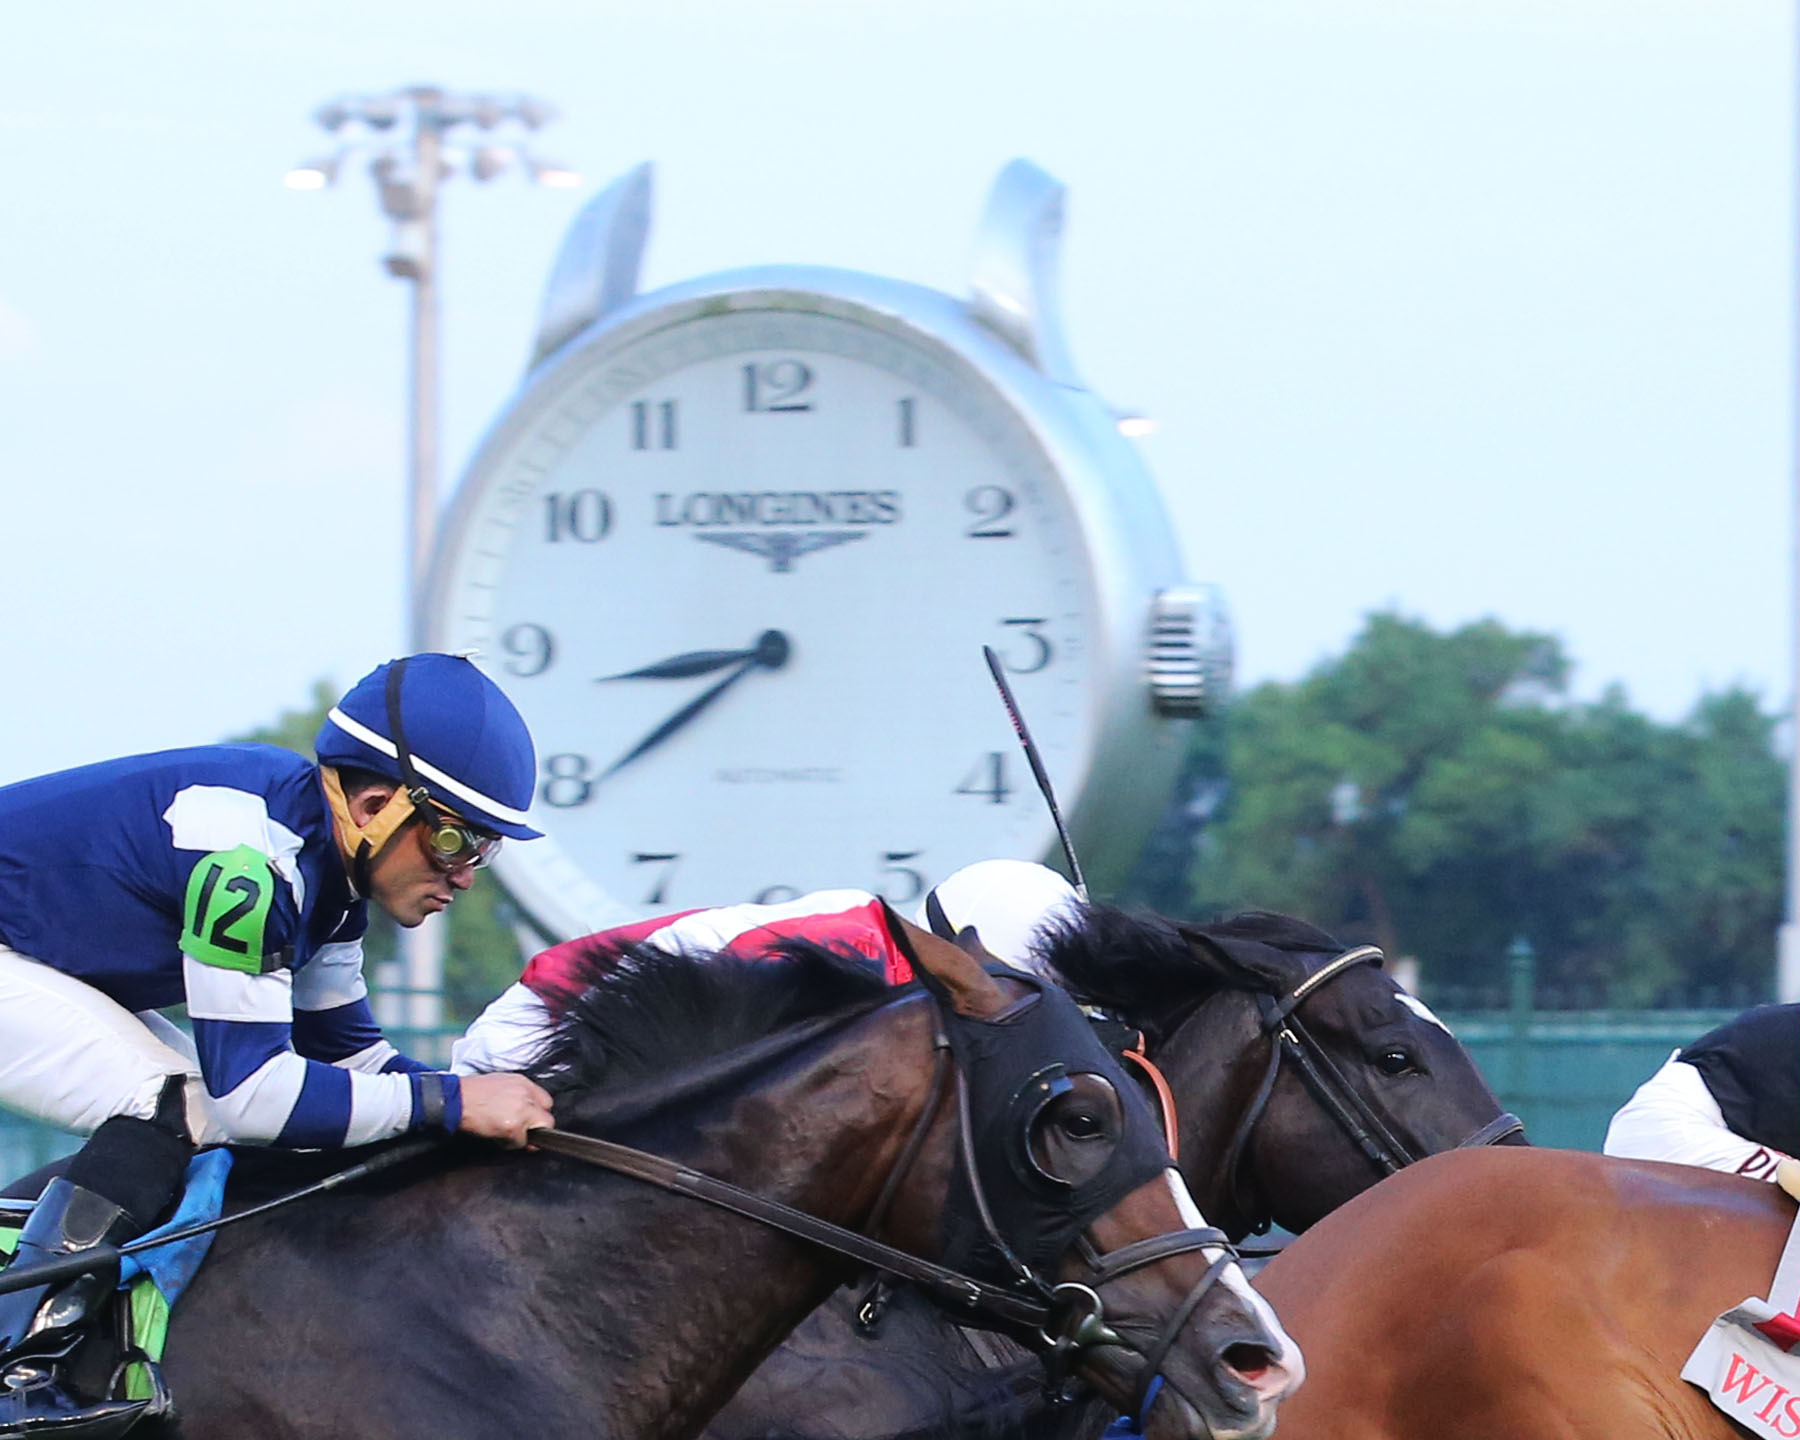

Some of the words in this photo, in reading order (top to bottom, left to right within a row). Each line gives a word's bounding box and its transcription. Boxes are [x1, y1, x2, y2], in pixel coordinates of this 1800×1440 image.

[742, 359, 815, 413] 12
[630, 399, 678, 450] 11
[895, 397, 917, 447] 1
[543, 488, 612, 543] 10
[654, 488, 901, 526] LONGINES
[964, 485, 1017, 538] 2
[502, 623, 555, 678] 9
[997, 616, 1054, 674] 3
[543, 752, 596, 807] 8
[954, 750, 1013, 805] 4
[630, 851, 681, 904] 7
[880, 851, 926, 905] 5
[192, 863, 261, 954] 12
